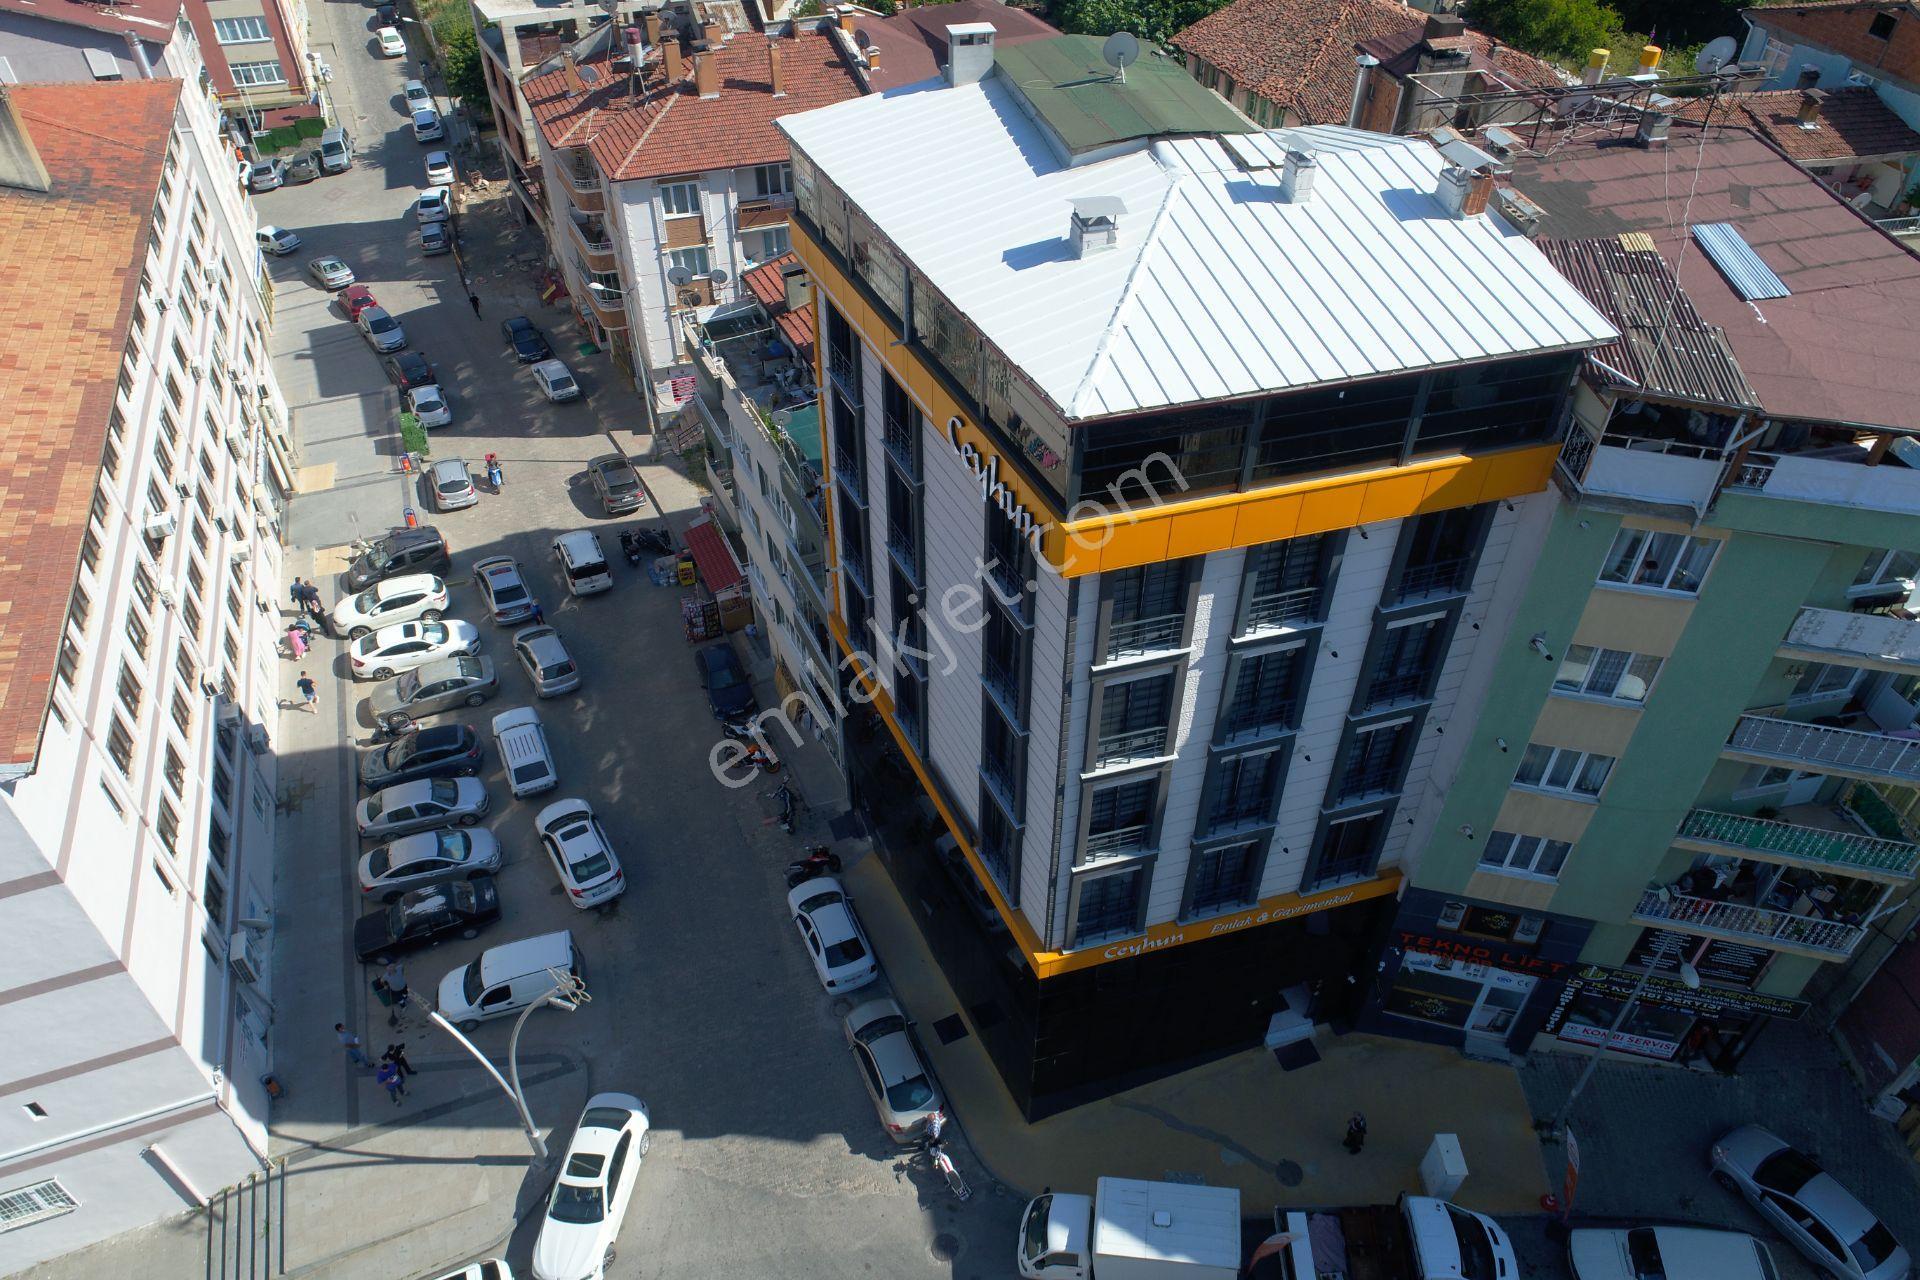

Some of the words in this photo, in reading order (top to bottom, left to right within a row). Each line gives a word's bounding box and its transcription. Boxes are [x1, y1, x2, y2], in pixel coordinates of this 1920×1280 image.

[947, 416, 1041, 552] Ceyhun
[1210, 916, 1252, 934] Emlak
[1256, 911, 1268, 923] &
[1272, 891, 1354, 918] Gayrimenkul
[1103, 933, 1184, 959] Ceyhun
[1401, 932, 1491, 958] TEKNO
